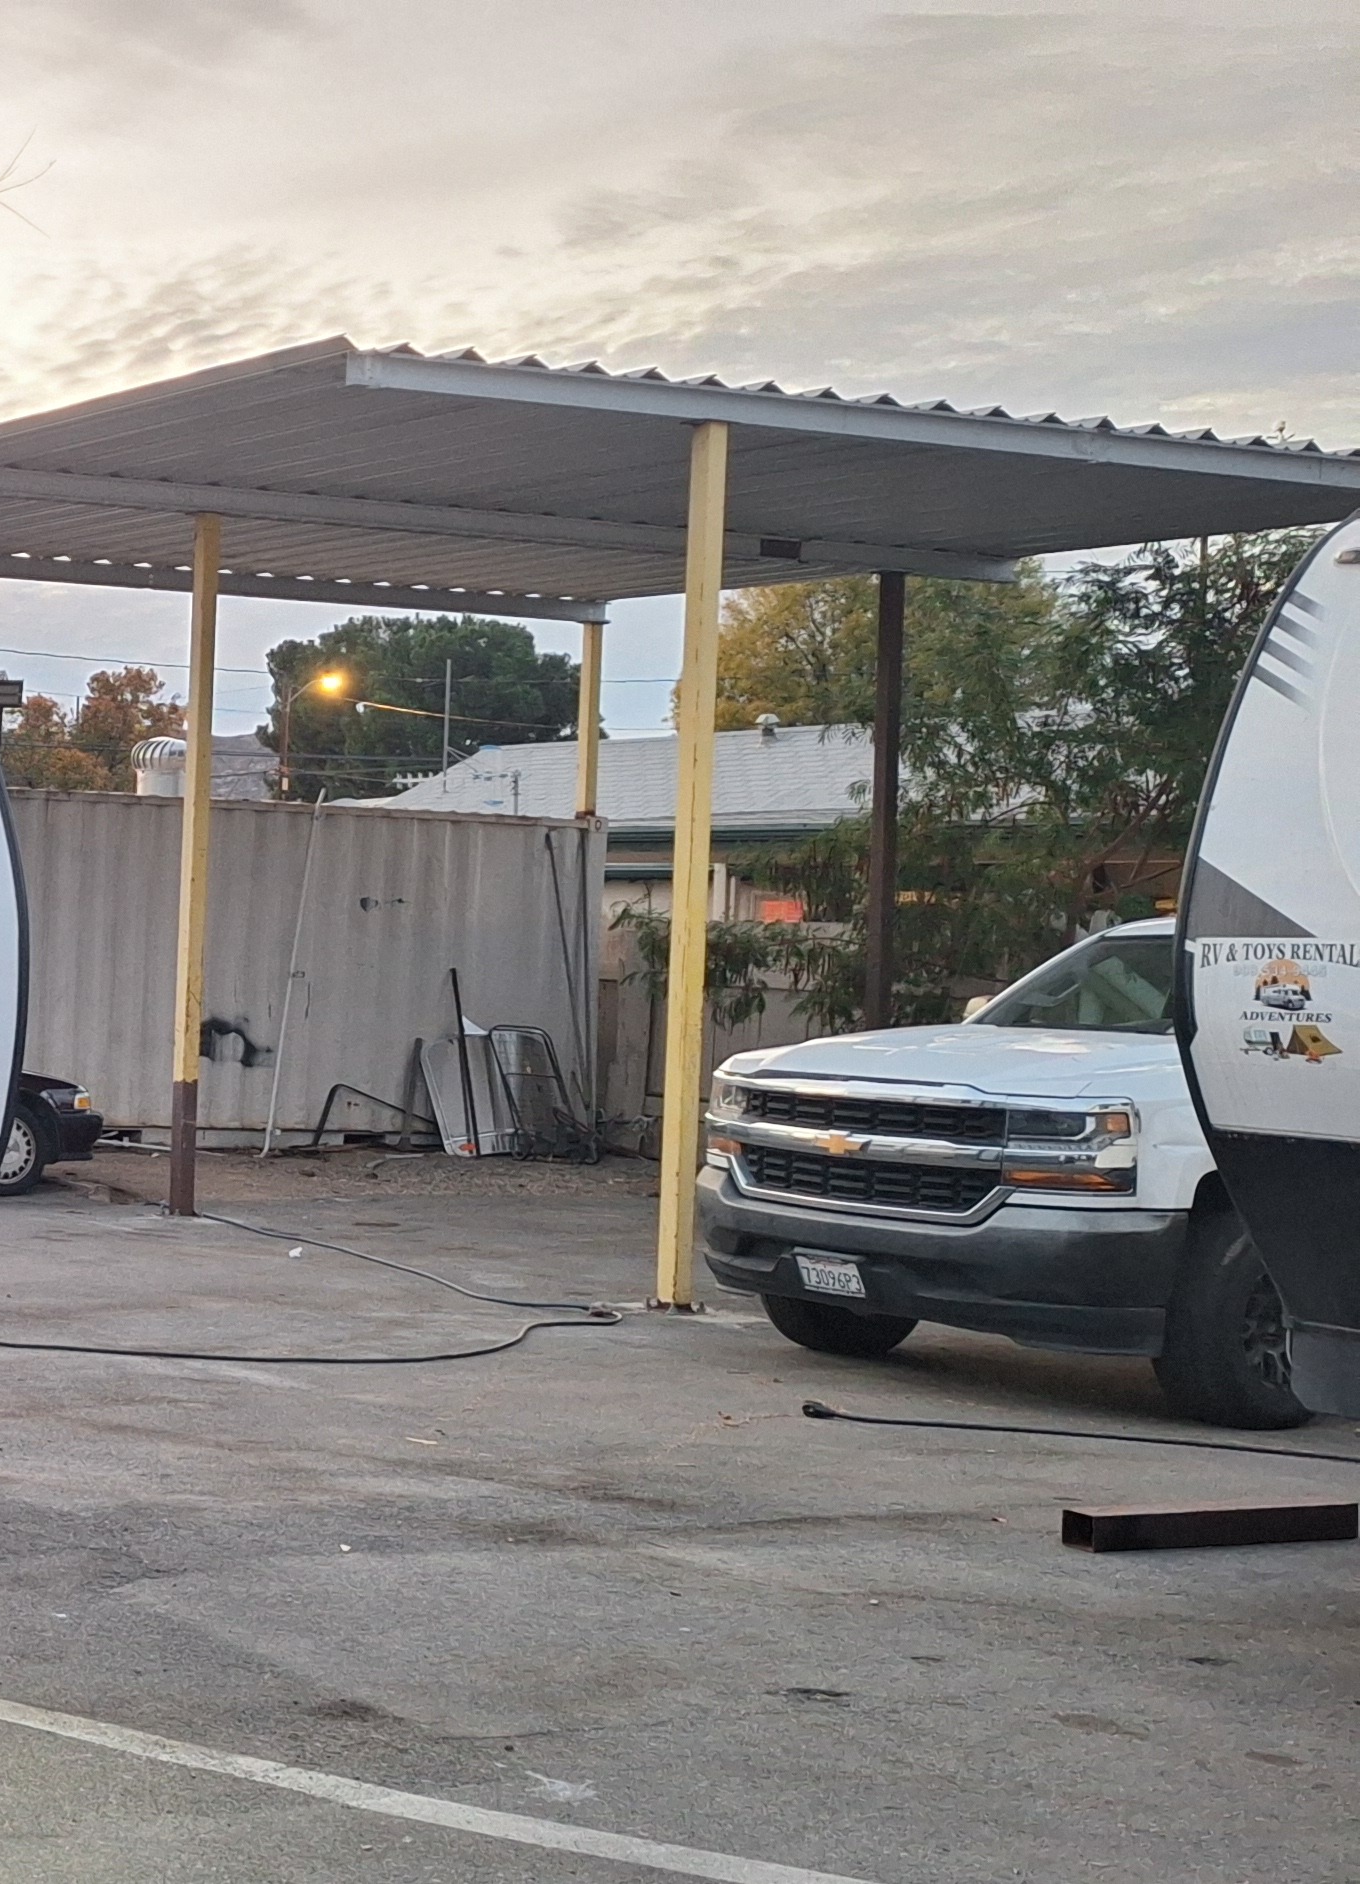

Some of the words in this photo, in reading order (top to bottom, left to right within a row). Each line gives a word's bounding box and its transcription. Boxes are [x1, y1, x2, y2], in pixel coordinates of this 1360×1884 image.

[1200, 943, 1223, 969] RV
[1226, 942, 1238, 962] &
[1242, 942, 1286, 961] TOYS
[1290, 943, 1360, 968] RENTAL
[1238, 1010, 1333, 1024] ADVENTURES
[800, 1265, 863, 1292] 73096P3
